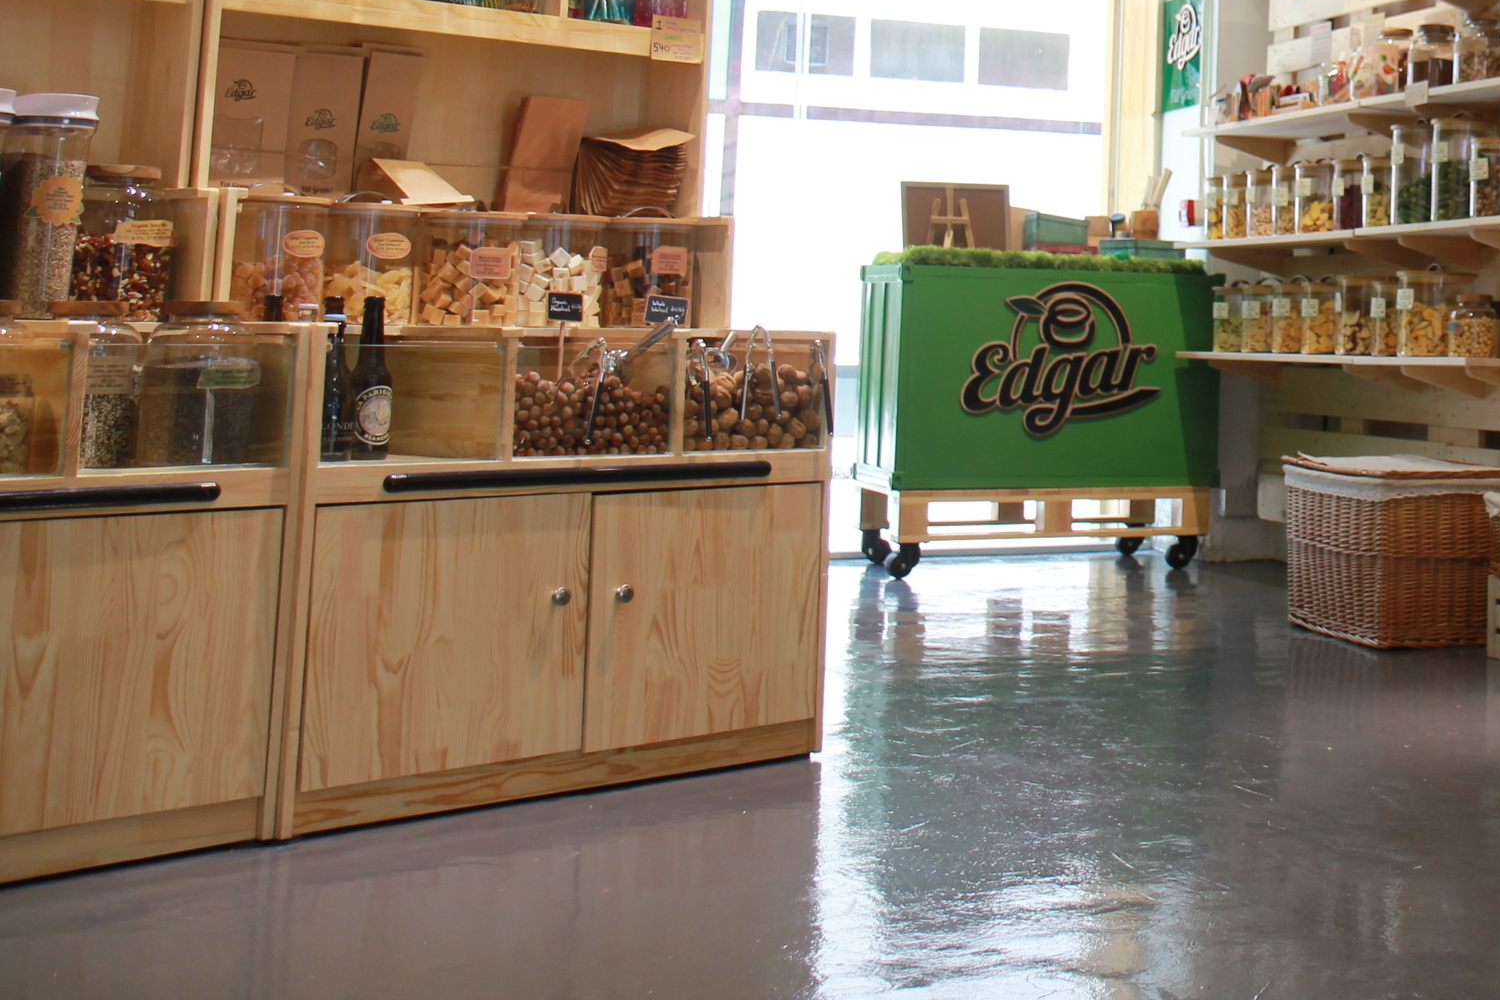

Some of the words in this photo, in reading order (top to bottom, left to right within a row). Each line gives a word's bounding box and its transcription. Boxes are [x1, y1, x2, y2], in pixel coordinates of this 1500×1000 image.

[653, 43, 670, 53] 540
[1167, 26, 1202, 71] Edgar
[224, 87, 257, 102] Edgar
[305, 116, 337, 131] Edgar
[370, 119, 401, 134] Edgar
[960, 340, 1161, 438] Edgar
